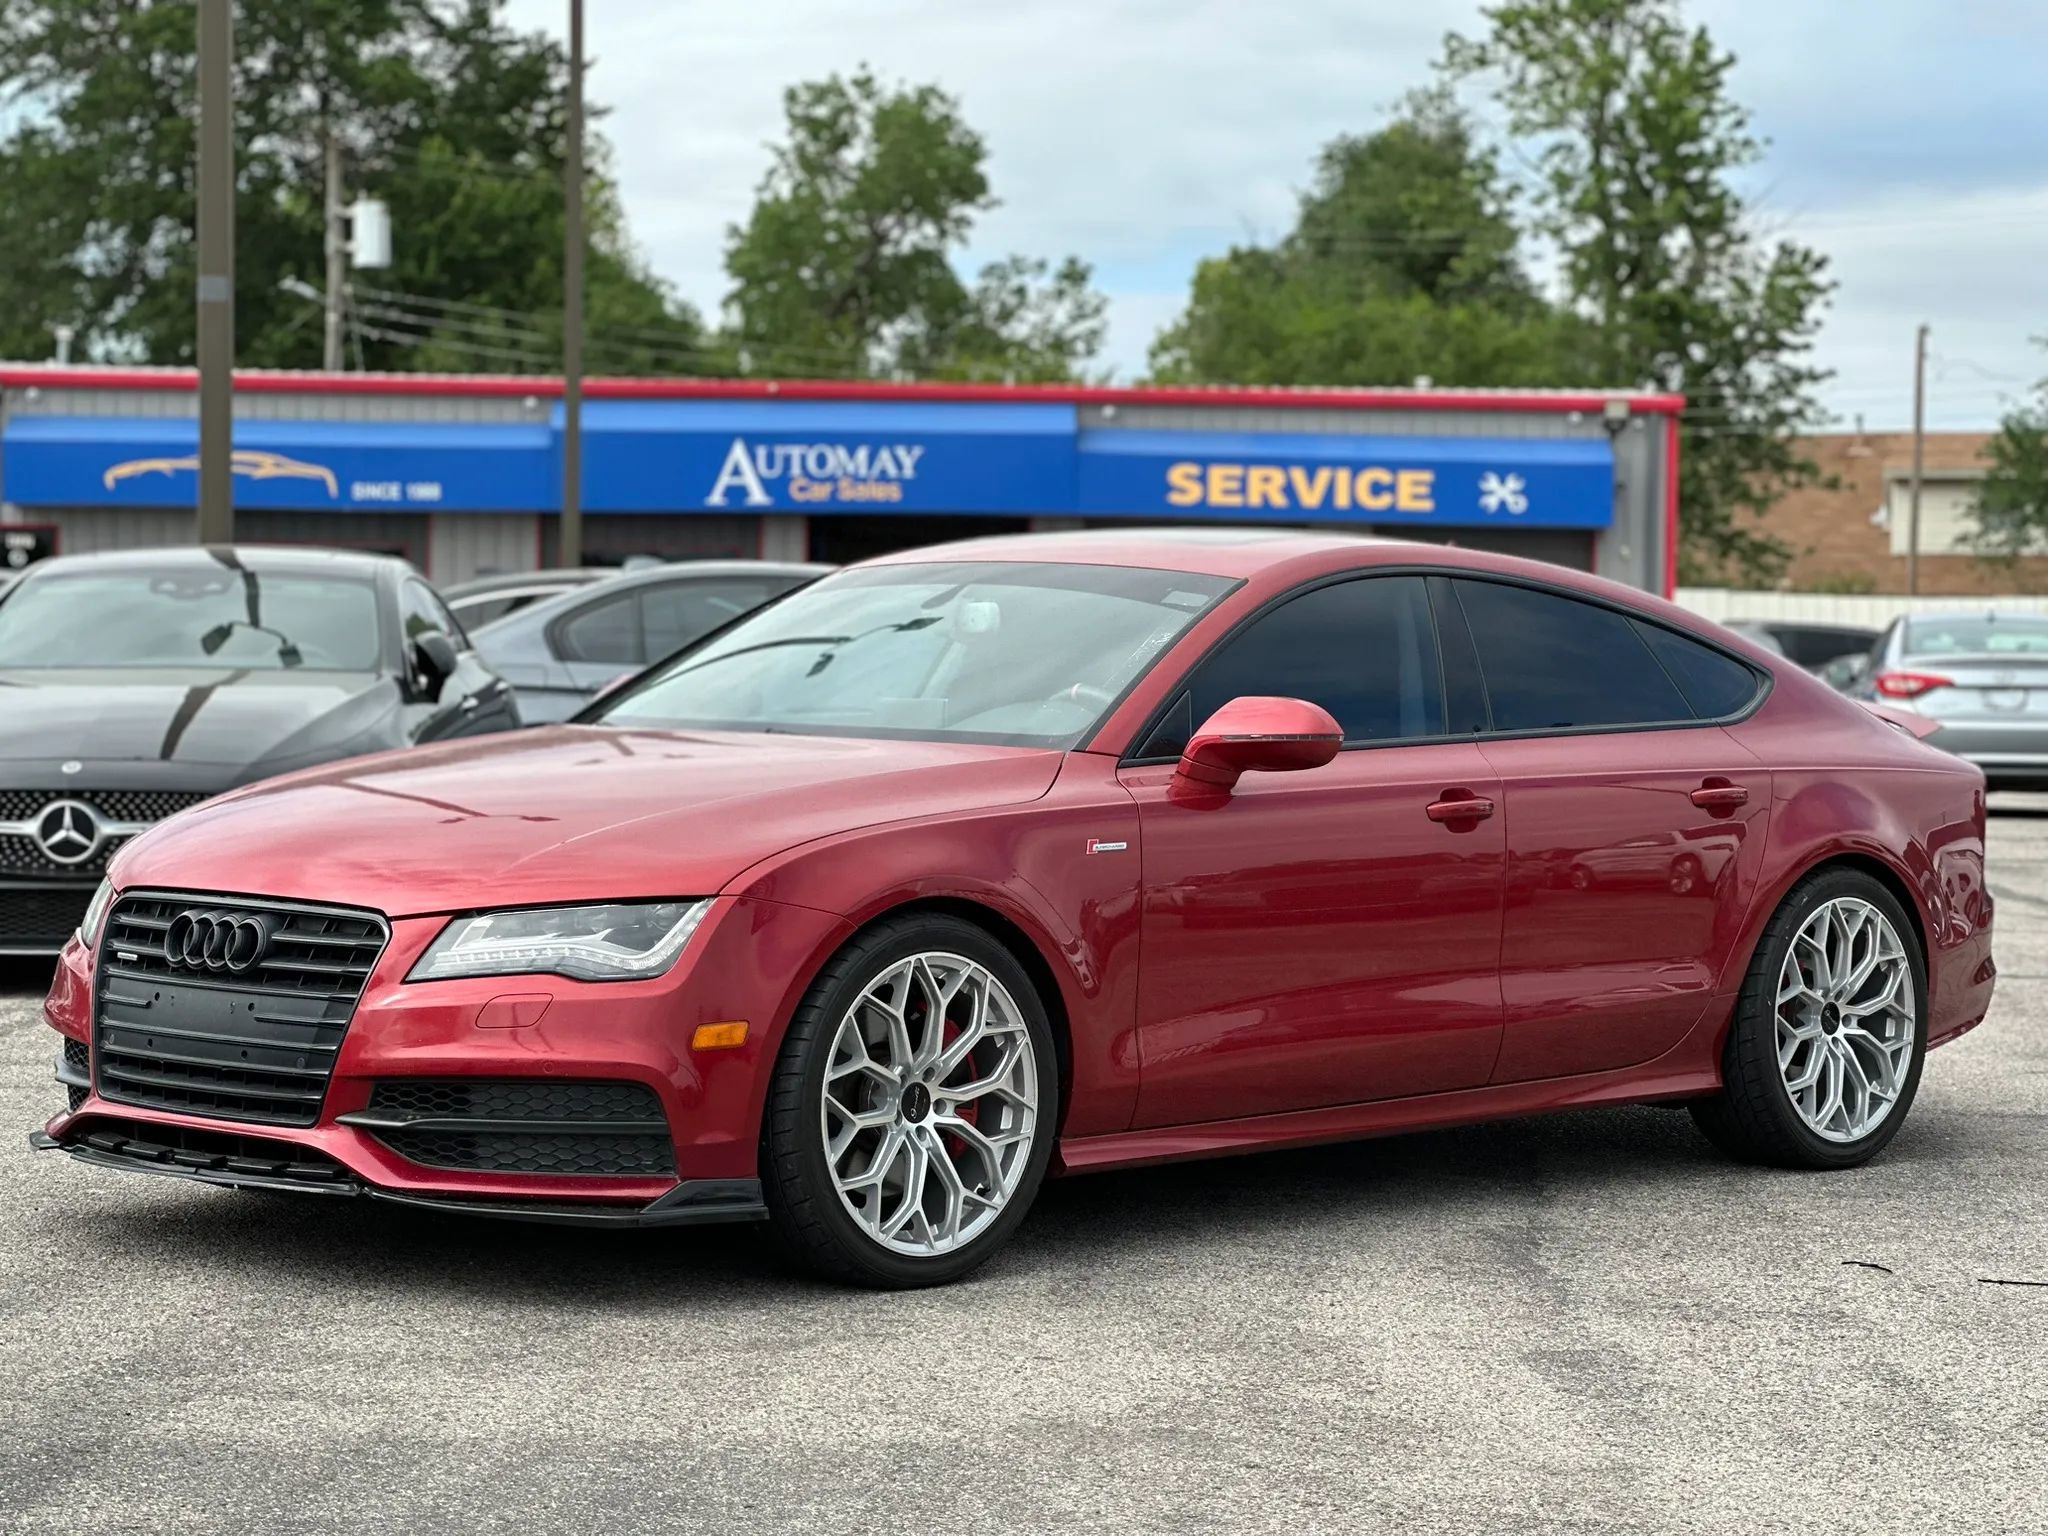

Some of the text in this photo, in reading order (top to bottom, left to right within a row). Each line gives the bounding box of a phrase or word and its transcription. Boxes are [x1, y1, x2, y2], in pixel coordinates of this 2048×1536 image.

[351, 481, 402, 501] SINCE
[704, 437, 924, 506] AUTOMAY
[789, 476, 903, 502] Car Sales
[1166, 461, 1436, 513] SERVICE
